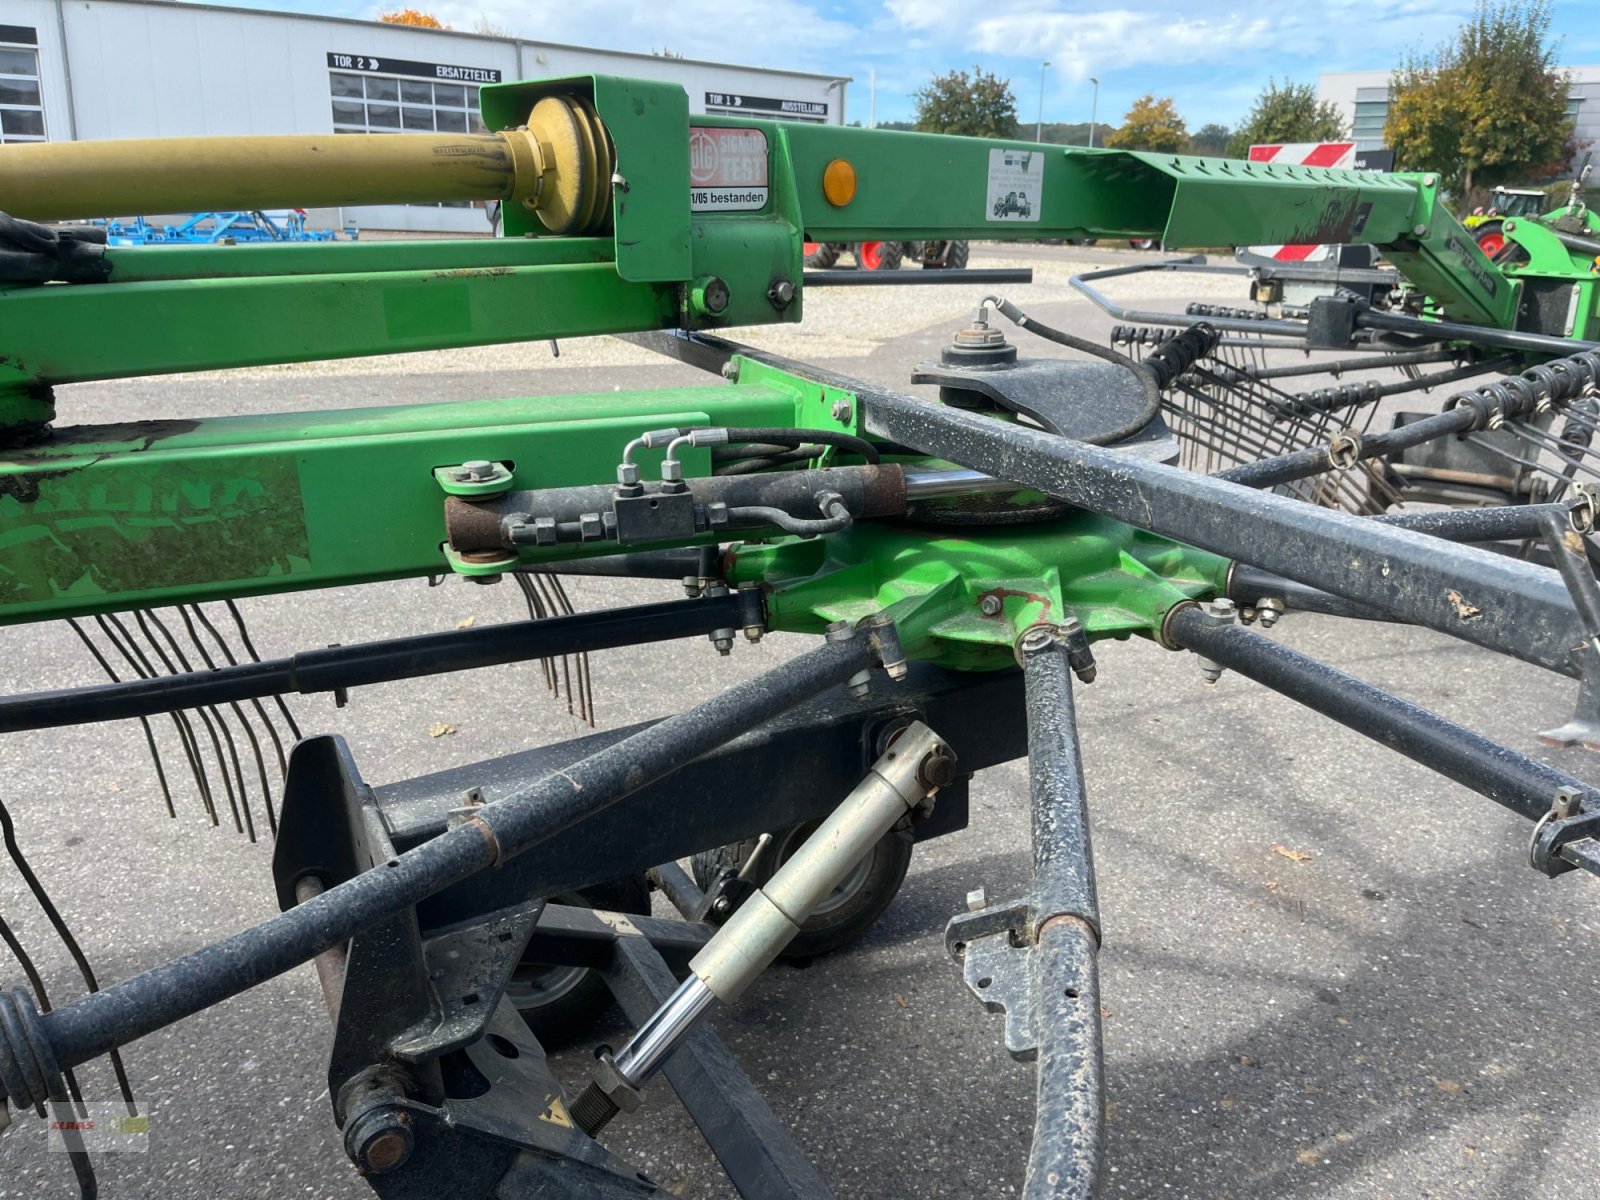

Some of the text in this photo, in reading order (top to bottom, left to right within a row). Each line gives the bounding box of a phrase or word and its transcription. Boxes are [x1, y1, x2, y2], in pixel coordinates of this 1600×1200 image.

[333, 55, 364, 69] TOR 2
[436, 66, 496, 82] ERSATZTEILE
[709, 94, 731, 106] TOR 1
[781, 101, 825, 114] AUSSTELLUNG
[722, 157, 763, 181] TEST
[710, 192, 764, 203] bestanden
